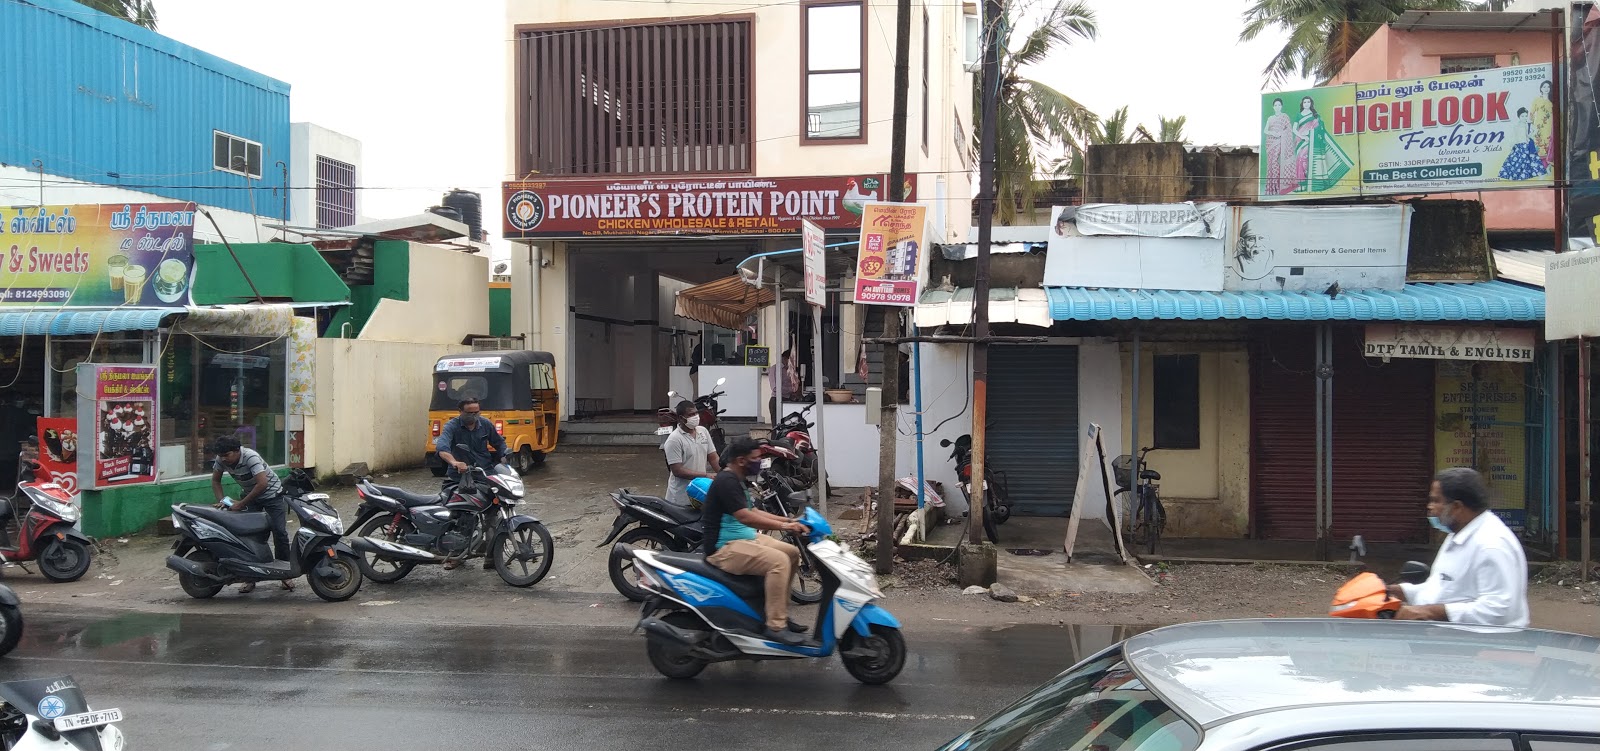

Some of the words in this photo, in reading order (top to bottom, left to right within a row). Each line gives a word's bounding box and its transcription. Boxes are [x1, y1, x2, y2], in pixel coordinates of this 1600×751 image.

[1395, 80, 1425, 98] லுக்
[1428, 74, 1485, 91] பேஷன்
[1333, 100, 1413, 135] HIGH
[1422, 91, 1510, 127] LOOK
[1399, 124, 1505, 150] Fashion
[1438, 148, 1470, 156] Womens
[1482, 145, 1503, 153] Kids
[1368, 172, 1389, 180] The
[1392, 169, 1417, 179] Best
[1420, 166, 1478, 178] Collection
[548, 193, 661, 219] PIONEER'S
[667, 191, 763, 218] PROTEIN
[770, 190, 839, 216] POINT
[11, 207, 76, 234] ஸ்வீட்ஸ்
[133, 205, 194, 231] திருமலா
[598, 219, 650, 229] CHICKEN
[652, 218, 727, 229] WHOLESALE
[728, 218, 735, 228] &
[737, 217, 778, 227] RETAIL
[1101, 211, 1120, 224] SAI
[9, 245, 23, 273] &
[28, 246, 89, 273] Sweets
[1293, 247, 1328, 255] Stationery
[15, 289, 70, 299] 8124993090
[1366, 343, 1395, 354] DTP
[1399, 344, 1445, 356] TAMIL
[1450, 346, 1459, 356] &
[1464, 347, 1532, 359] ENGLISH
[1460, 382, 1477, 391] SR
[1482, 382, 1499, 391] SAI
[1443, 392, 1517, 403] ENTEPRISES
[64, 719, 74, 728] TN
[80, 715, 91, 725] 22
[103, 711, 119, 721] 7113
